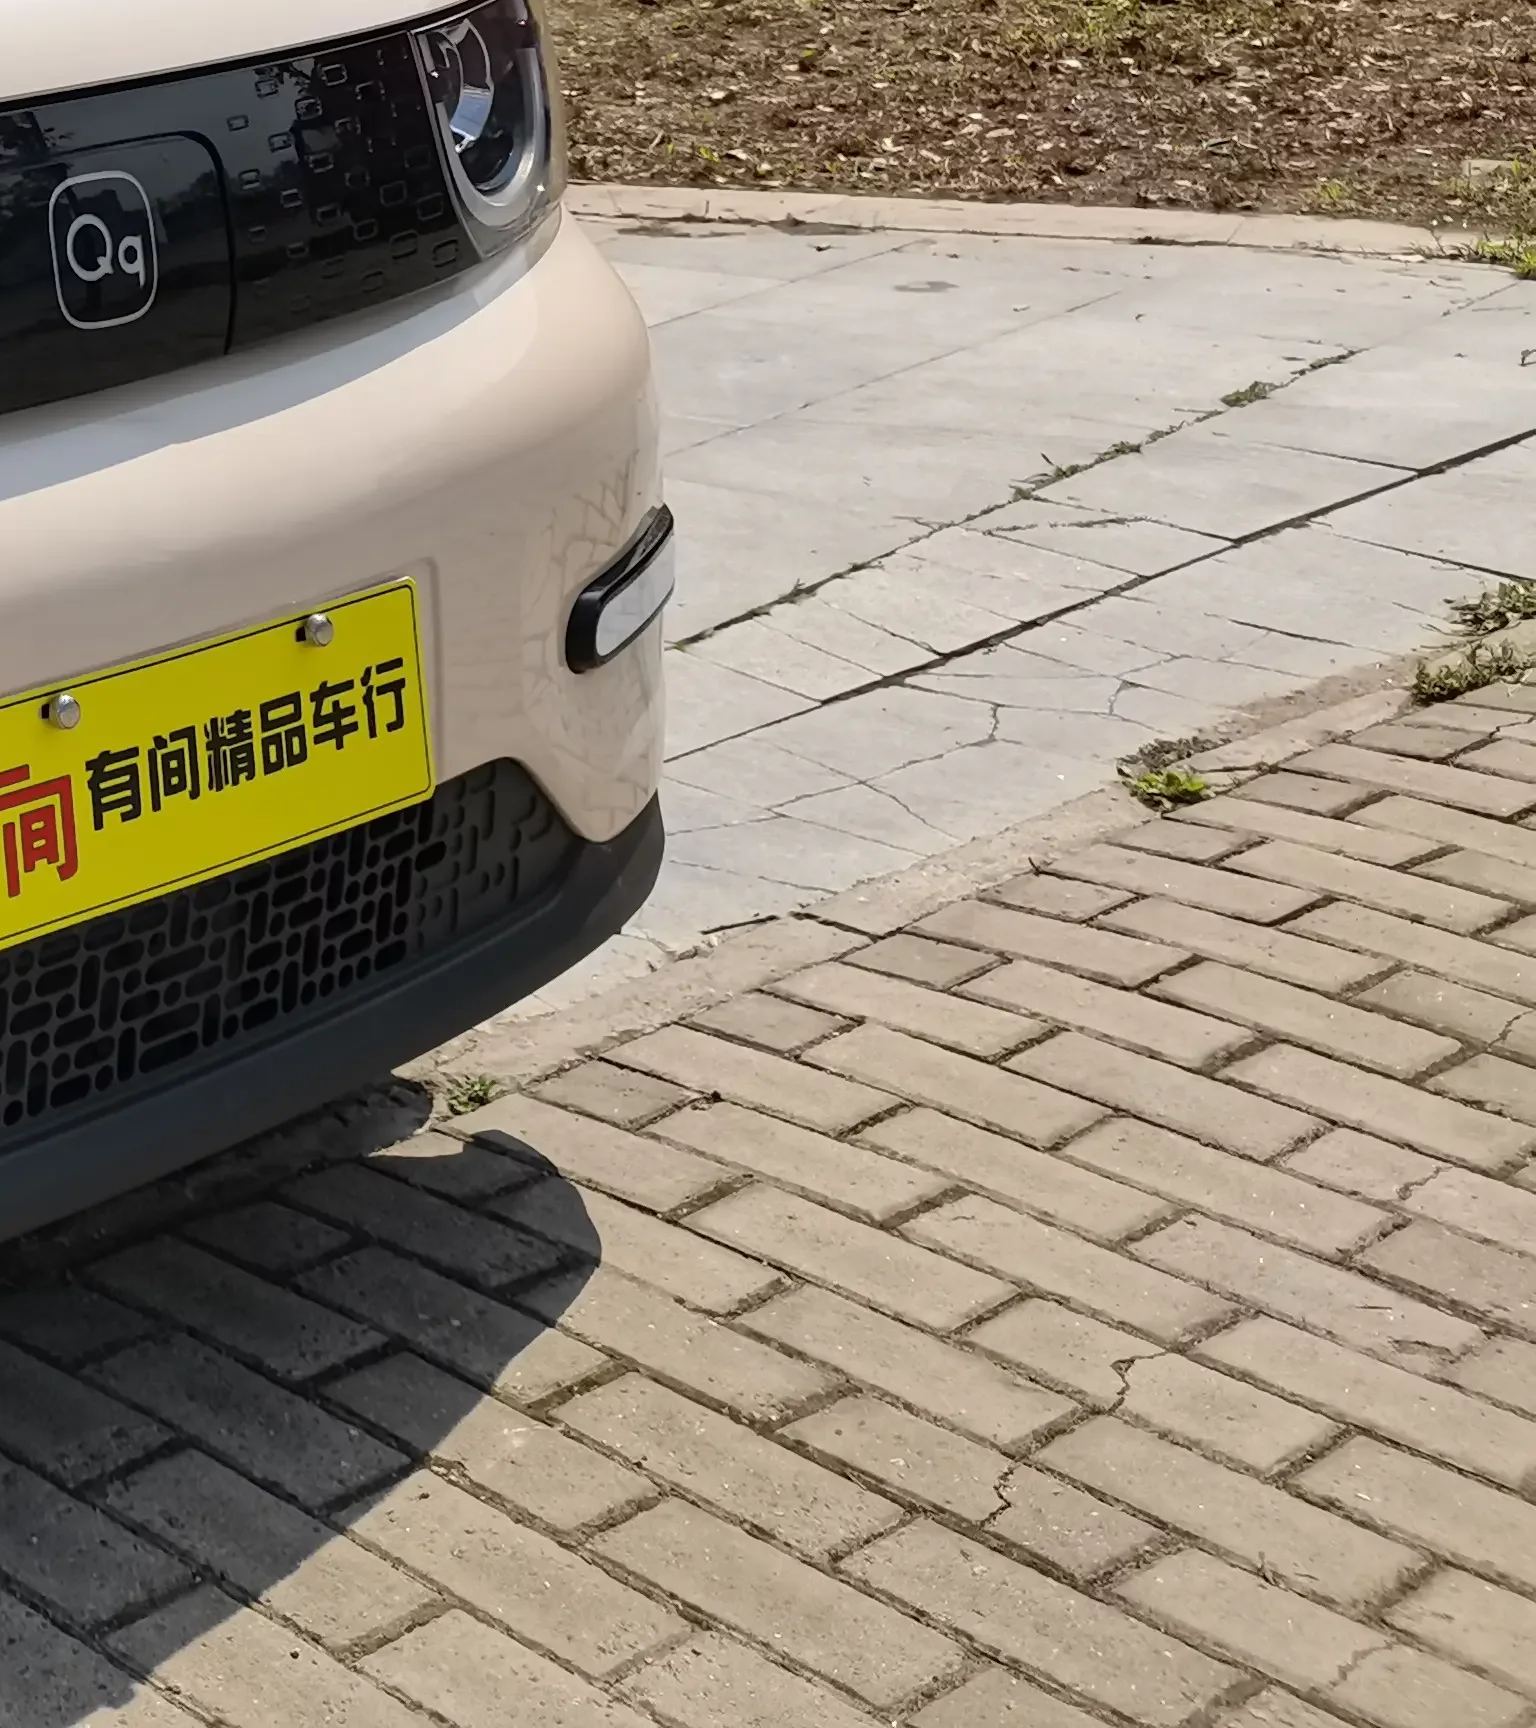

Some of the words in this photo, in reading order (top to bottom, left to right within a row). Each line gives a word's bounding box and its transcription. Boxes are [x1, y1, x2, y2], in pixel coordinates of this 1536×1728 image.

[85, 656, 407, 831] 有间精品车行
